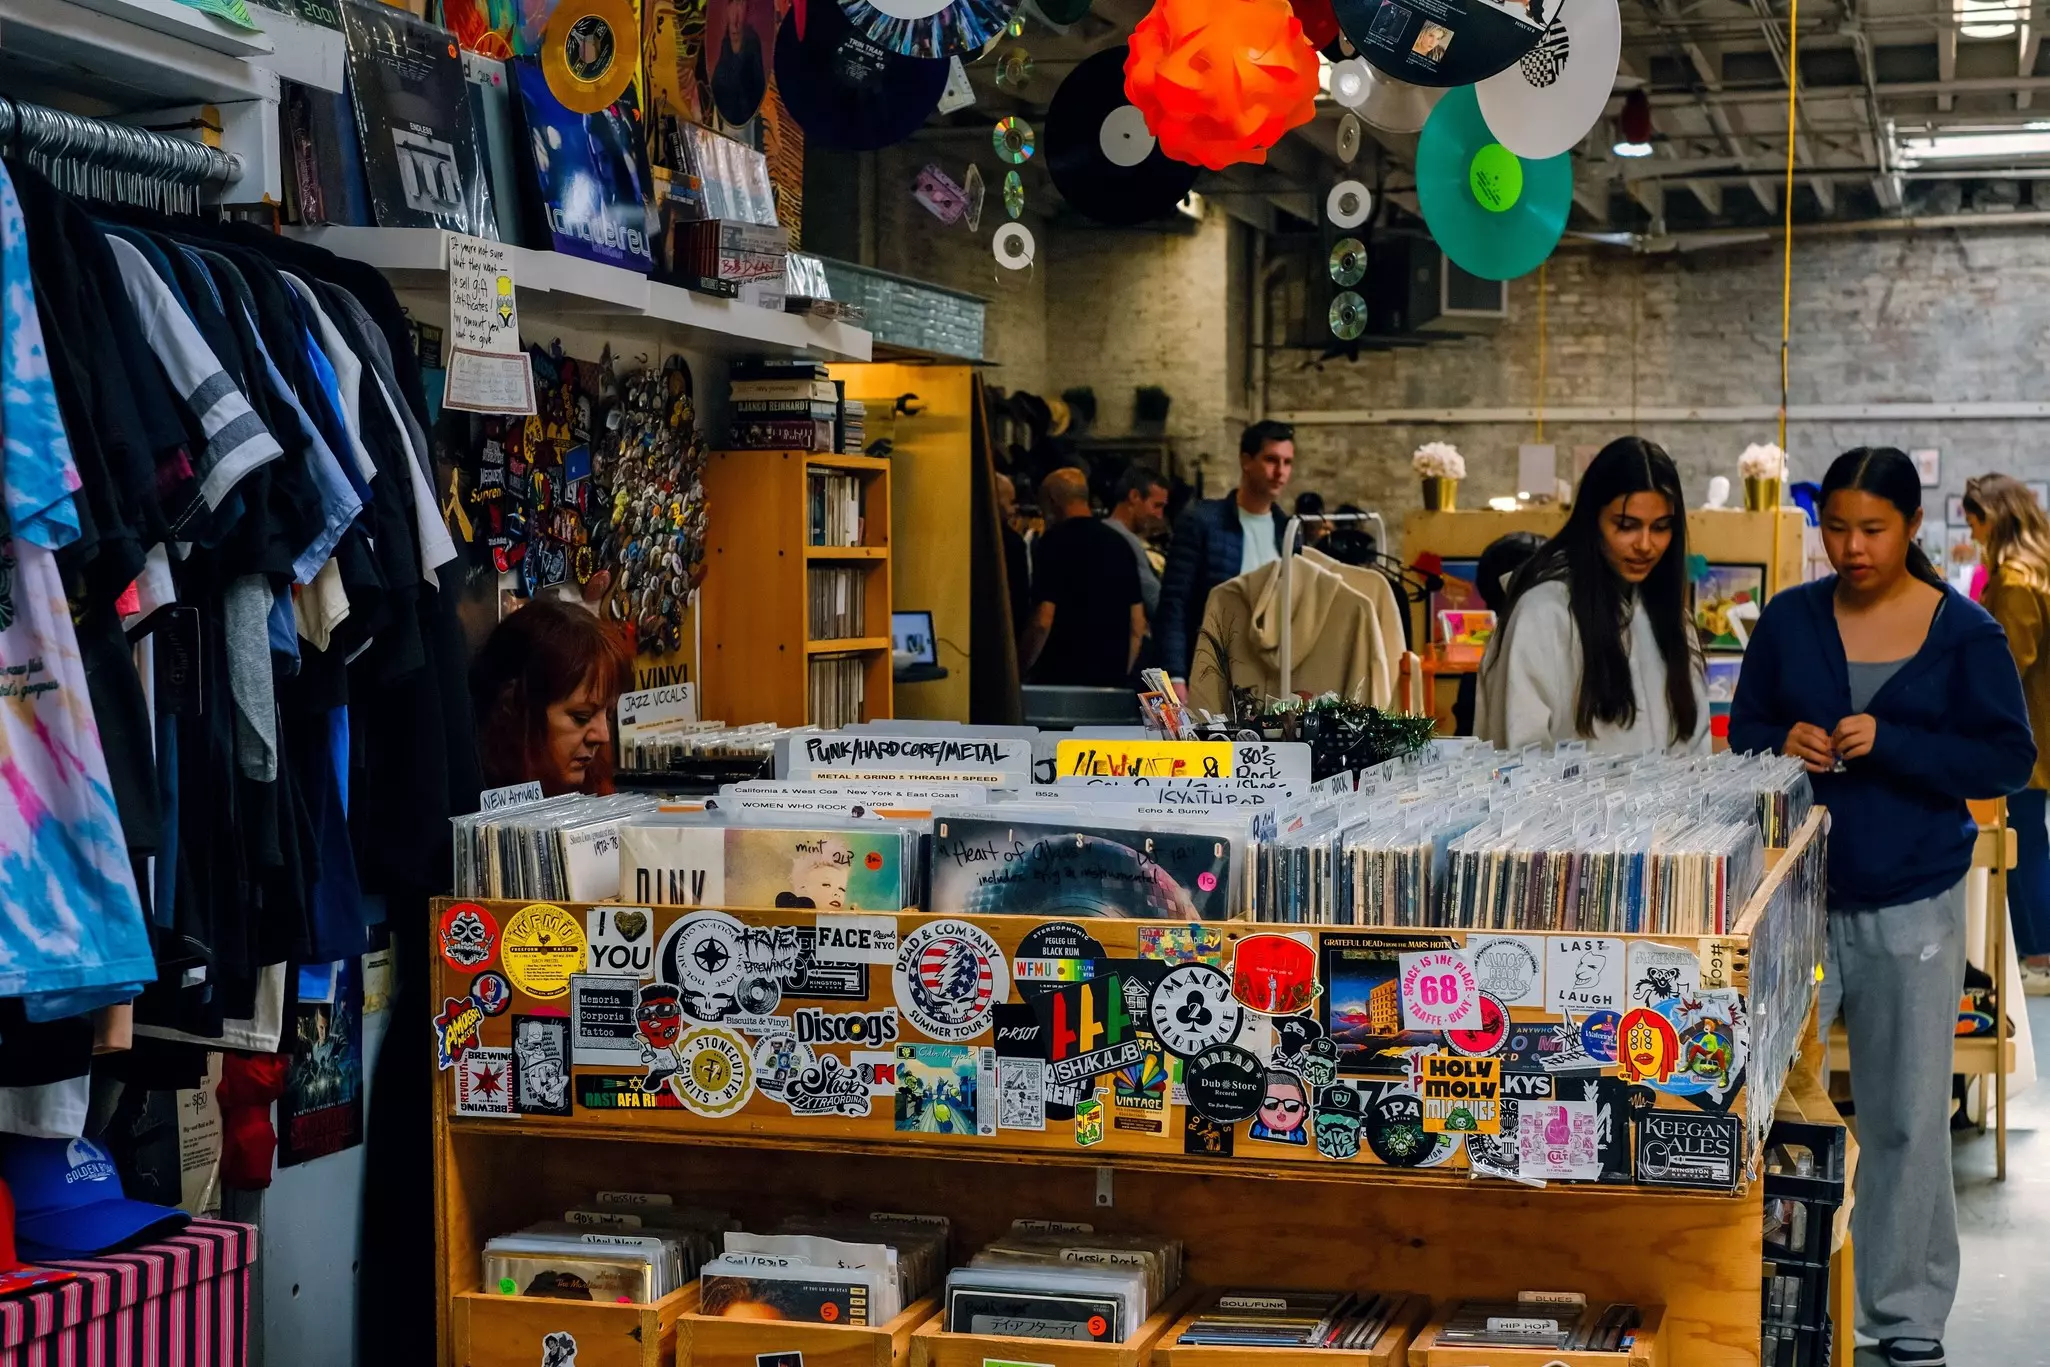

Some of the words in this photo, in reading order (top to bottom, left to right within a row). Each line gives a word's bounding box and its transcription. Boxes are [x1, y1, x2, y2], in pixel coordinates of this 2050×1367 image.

[304, 5, 336, 25] 2001
[409, 122, 433, 136] ENDLESS
[478, 244, 488, 258] not
[490, 250, 504, 260] sure
[469, 257, 481, 277] they
[483, 264, 497, 276] want
[459, 276, 470, 290] sell
[472, 279, 488, 300] gift
[464, 315, 487, 331] amount
[488, 320, 500, 337] you
[469, 330, 476, 344] to
[738, 401, 767, 412] DJANGO
[769, 400, 809, 411] REINHARDT
[625, 694, 651, 712] JAZZ
[653, 687, 688, 706] VOCALS
[1239, 744, 1275, 765] 80's
[482, 791, 506, 811] NEW
[508, 786, 540, 806] Arrivals
[734, 787, 778, 795] California
[872, 789, 892, 797] York
[816, 803, 847, 811] ROCK
[1179, 807, 1210, 815] Bunny
[796, 840, 828, 855] mint
[1004, 842, 1026, 862] of
[1080, 867, 1161, 885] instrumental
[1203, 876, 1214, 885] 10
[513, 913, 573, 939] WFMU
[598, 911, 606, 936] I
[678, 928, 697, 950] who
[819, 927, 871, 949] FACE
[1032, 925, 1090, 941] STEREOPHONIC
[1045, 937, 1066, 945] PEGLEG
[1067, 937, 1077, 945] LEE
[873, 941, 895, 950] NYC
[895, 937, 920, 973] DEAD
[921, 929, 932, 940] &
[935, 923, 1000, 959] COMPANY
[1042, 947, 1063, 956] BLACK
[1065, 947, 1080, 956] RUM
[1324, 938, 1361, 947] GRATEFUL
[1362, 939, 1383, 948] DEAD
[1408, 940, 1429, 949] MARS
[1560, 941, 1605, 953] LAST
[591, 945, 651, 969] YOU
[679, 957, 688, 971] all
[1017, 962, 1052, 976] WFMU
[1403, 964, 1421, 997] SPACE
[1420, 956, 1432, 968] IS
[1434, 954, 1453, 966] THE
[1454, 961, 1476, 992] PLACE
[1490, 967, 1520, 980] READY
[686, 970, 705, 986] not
[715, 972, 739, 988] lost
[1162, 969, 1230, 1003] MAC'S
[1479, 978, 1531, 992] RECORDS
[1420, 975, 1458, 1006] 68
[1559, 990, 1612, 1005] LAUGH
[580, 994, 621, 1004] Memoria
[580, 1011, 625, 1022] Corporis
[1188, 1003, 1201, 1020] 2
[1409, 1002, 1442, 1025] TAAFFE
[1448, 999, 1473, 1024] BKNY
[726, 1016, 757, 1026] Biscuits
[759, 1017, 766, 1026] &
[767, 1017, 790, 1028] Vinyl
[796, 1011, 896, 1046] Discogs
[909, 1009, 951, 1038] SUMMER
[954, 1021, 985, 1038] TOUR
[1155, 1003, 1185, 1049] CLUB
[1188, 1011, 1236, 1052] DEUCE
[581, 1028, 615, 1037] Tattoo
[997, 1026, 1040, 1040] P-RIOT
[1318, 1041, 1329, 1051] DJ
[468, 1052, 513, 1061] BREWING
[1058, 1044, 1139, 1080] SHAKALAB
[1198, 1051, 1255, 1073] DREAD
[696, 1037, 744, 1100] STONECUTTER
[1430, 1060, 1493, 1078] HOLY
[1201, 1078, 1221, 1088] Dub
[1231, 1080, 1257, 1091] Store
[1426, 1080, 1497, 1099] MOLY
[1214, 1089, 1238, 1097] Records
[1334, 1092, 1348, 1103] DJ
[461, 1103, 508, 1113] BREWING
[1116, 1096, 1162, 1110] VINTAGE
[1380, 1101, 1420, 1121] IPA
[1646, 1117, 1730, 1139] KEEGAN
[1668, 1138, 1730, 1155] ALES
[66, 1163, 99, 1184] GOLDEN
[1671, 1167, 1709, 1175] KINGSTON
[603, 1193, 647, 1204] Classics
[574, 1213, 593, 1224] 90's
[1500, 1322, 1520, 1330] HIP
[1525, 1322, 1550, 1330] HOP
